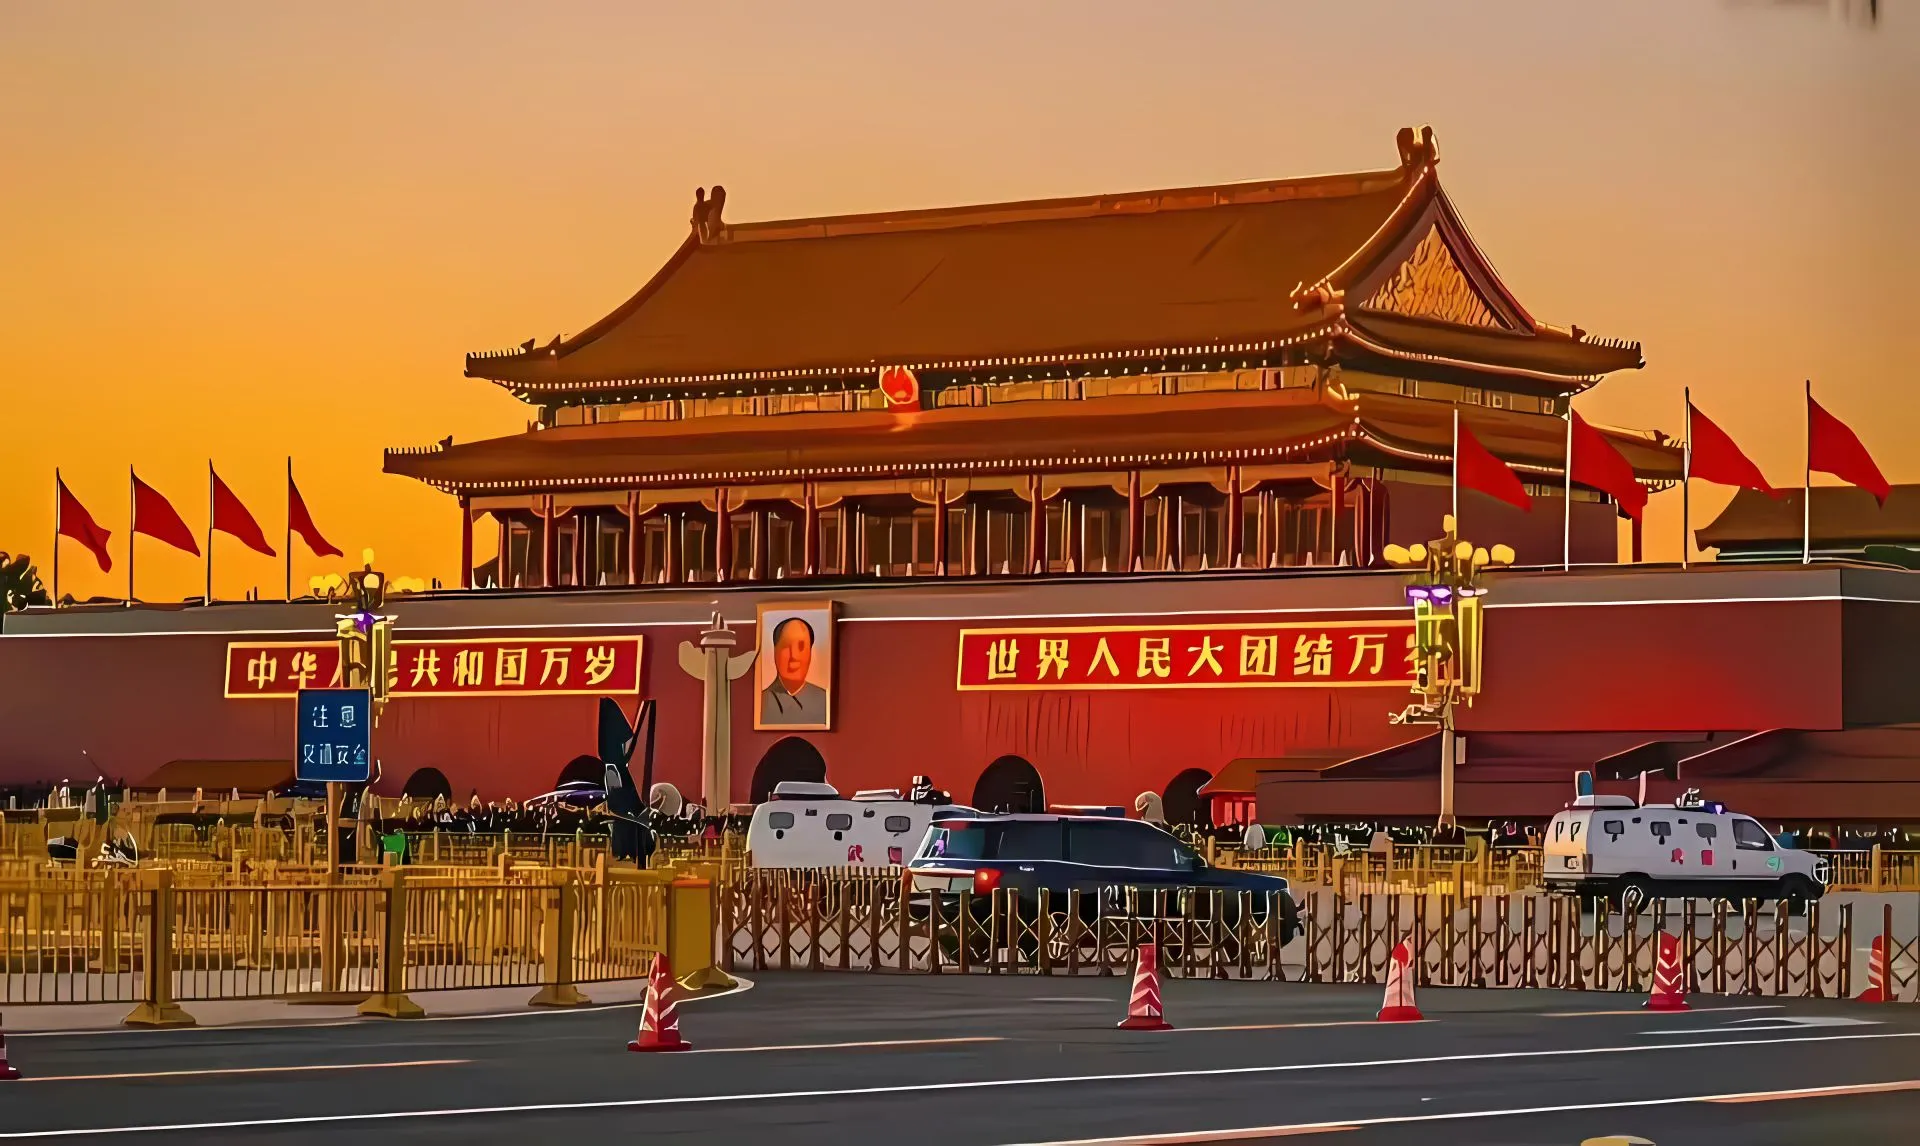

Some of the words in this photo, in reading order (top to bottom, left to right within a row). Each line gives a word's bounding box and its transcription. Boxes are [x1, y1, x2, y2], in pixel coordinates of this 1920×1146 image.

[247, 646, 616, 690] 中华共和国万岁
